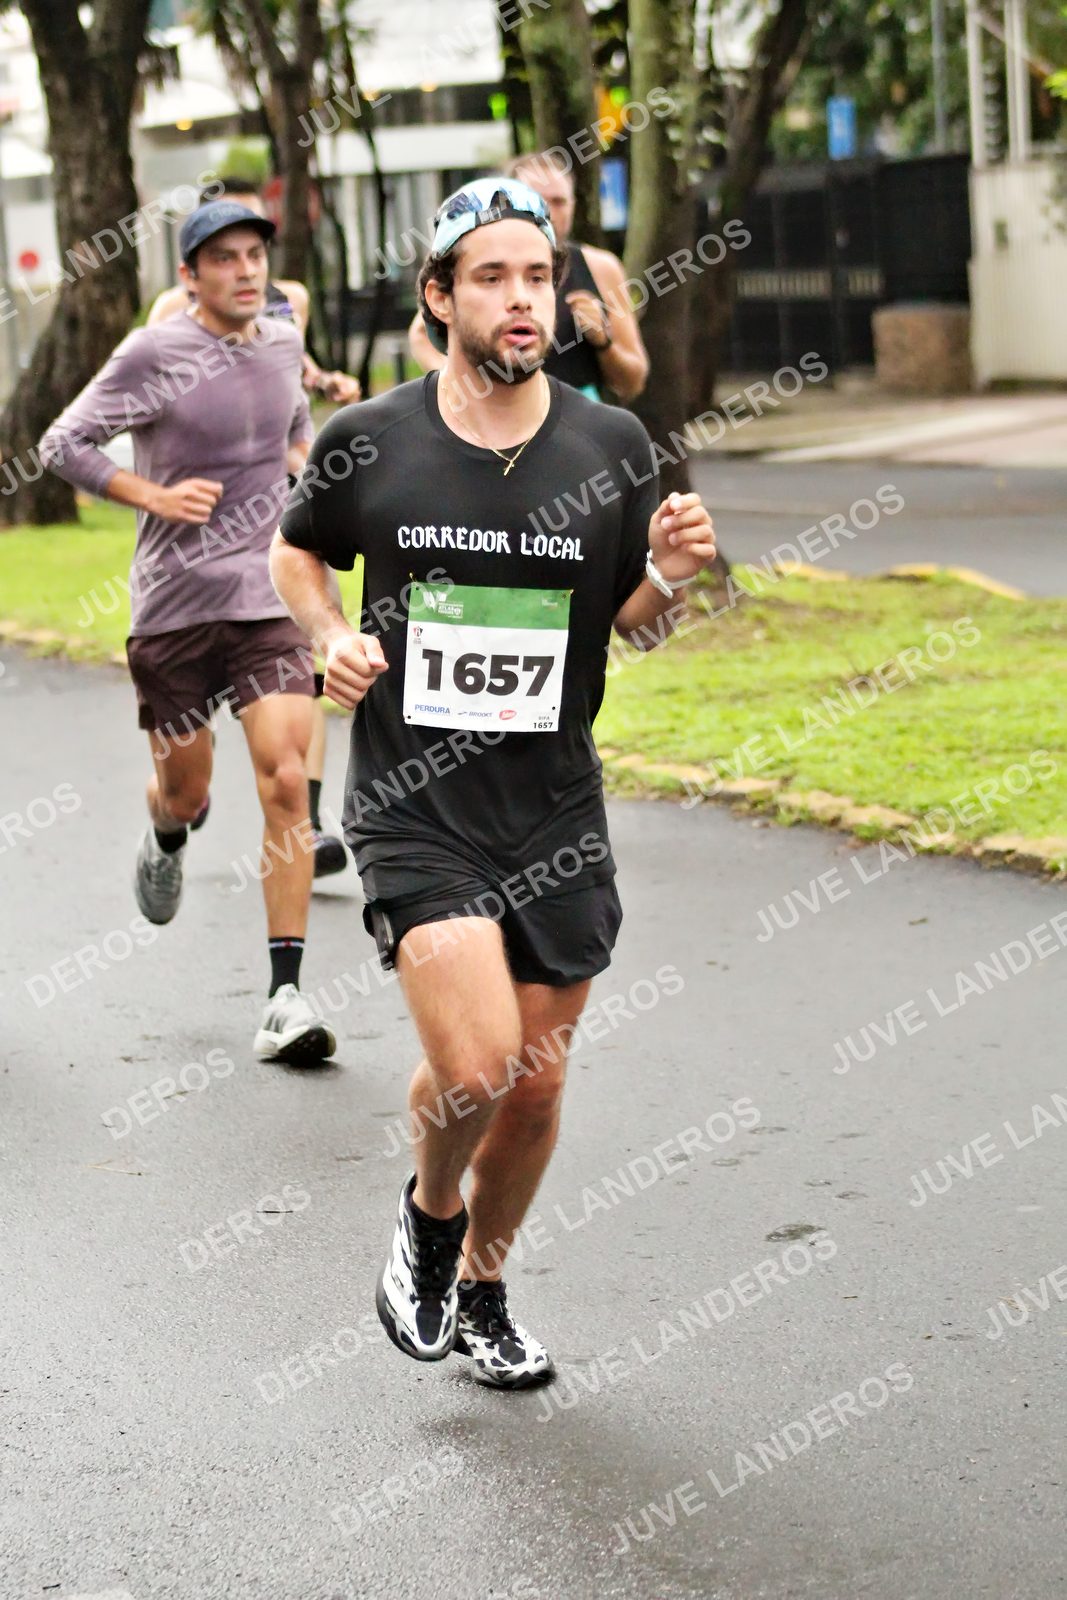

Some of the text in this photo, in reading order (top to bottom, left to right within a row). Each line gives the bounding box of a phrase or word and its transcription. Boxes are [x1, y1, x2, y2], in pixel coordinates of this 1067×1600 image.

[397, 525, 584, 561] CORREDOR LOCAL
[422, 648, 555, 696] 1657
[414, 704, 450, 715] PERDURA
